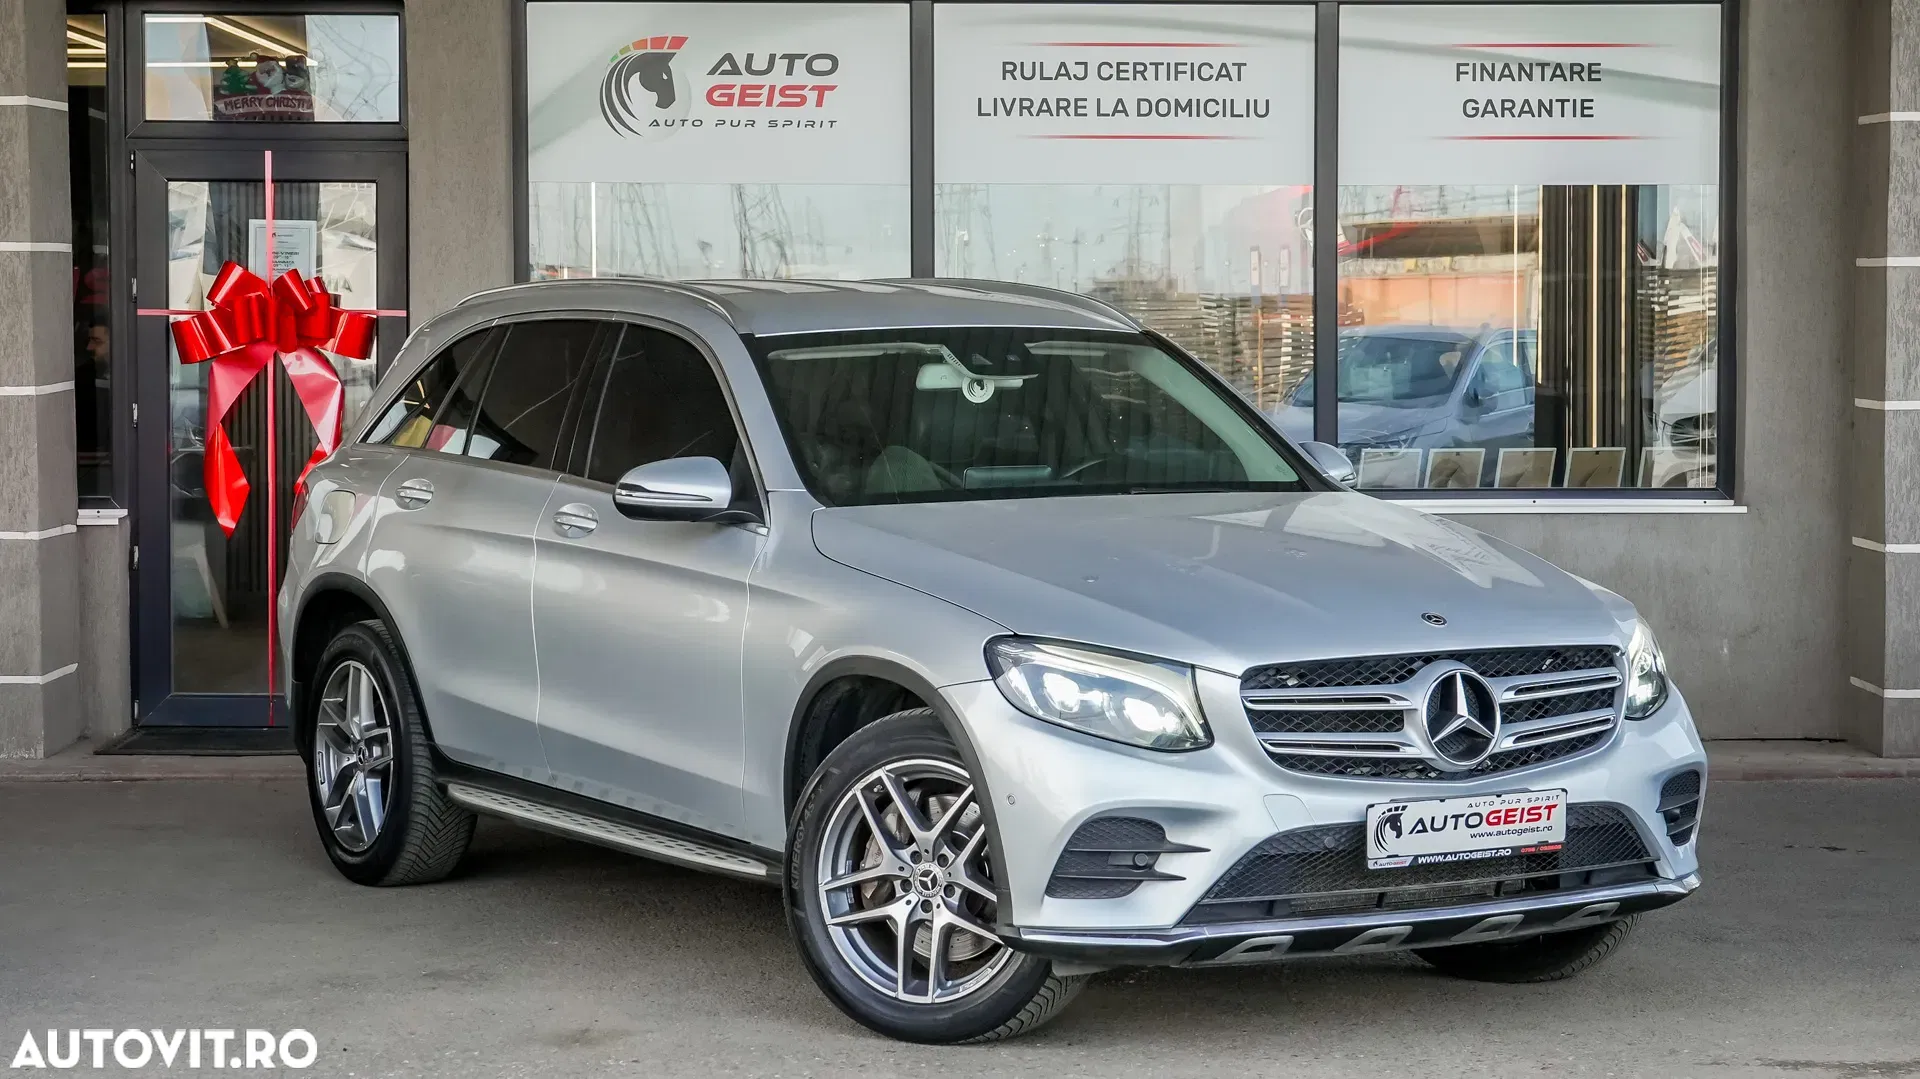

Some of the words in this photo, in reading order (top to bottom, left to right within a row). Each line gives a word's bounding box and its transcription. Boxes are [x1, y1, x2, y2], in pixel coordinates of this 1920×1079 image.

[706, 52, 840, 77] AUTO
[1001, 61, 1089, 81] RULAJ
[1096, 61, 1247, 82] CERTIFICAT
[1456, 62, 1602, 82] FINANTARE
[223, 97, 263, 111] MERRY
[705, 84, 839, 108] GEIST
[977, 97, 1088, 117] LIVRARE
[1096, 97, 1130, 118] LA
[1136, 98, 1270, 118] DOMICILIU
[1462, 98, 1595, 118] GARANTIE
[648, 118, 704, 128] AUTO
[715, 119, 756, 128] PUR
[767, 119, 838, 129] SPIRIT
[1467, 800, 1495, 809] AUTO
[1527, 794, 1560, 803] SPIRIT
[1408, 803, 1559, 835] AUTOGEIST
[1469, 825, 1553, 839] www.autogeist.ro
[791, 820, 805, 889] KINERGY
[1417, 848, 1512, 864] WWW.AUTOGEIST.RO
